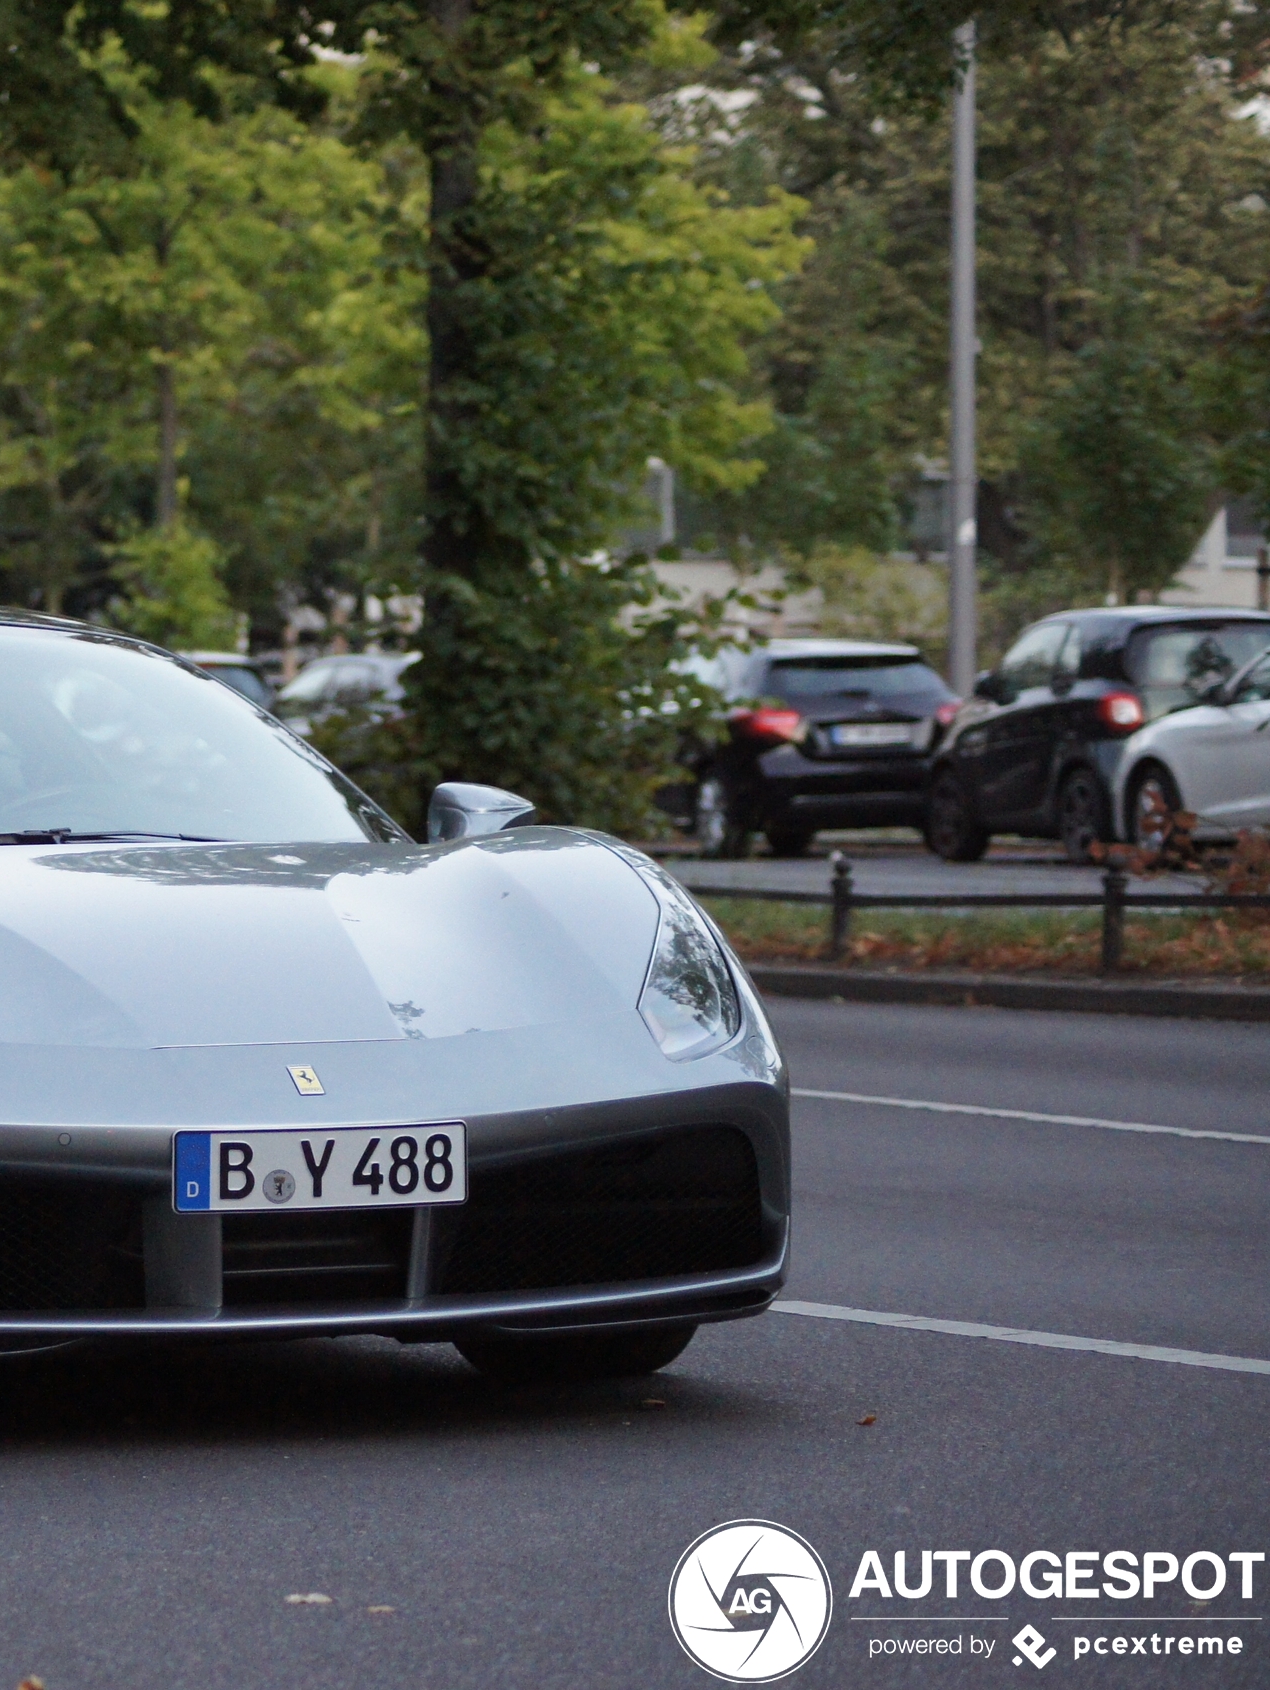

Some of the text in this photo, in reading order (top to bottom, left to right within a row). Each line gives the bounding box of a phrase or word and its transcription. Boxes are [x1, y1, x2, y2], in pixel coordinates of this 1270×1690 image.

[219, 1142, 255, 1200] B
[300, 1139, 336, 1198] Y
[352, 1133, 454, 1196] 488
[186, 1181, 200, 1198] D
